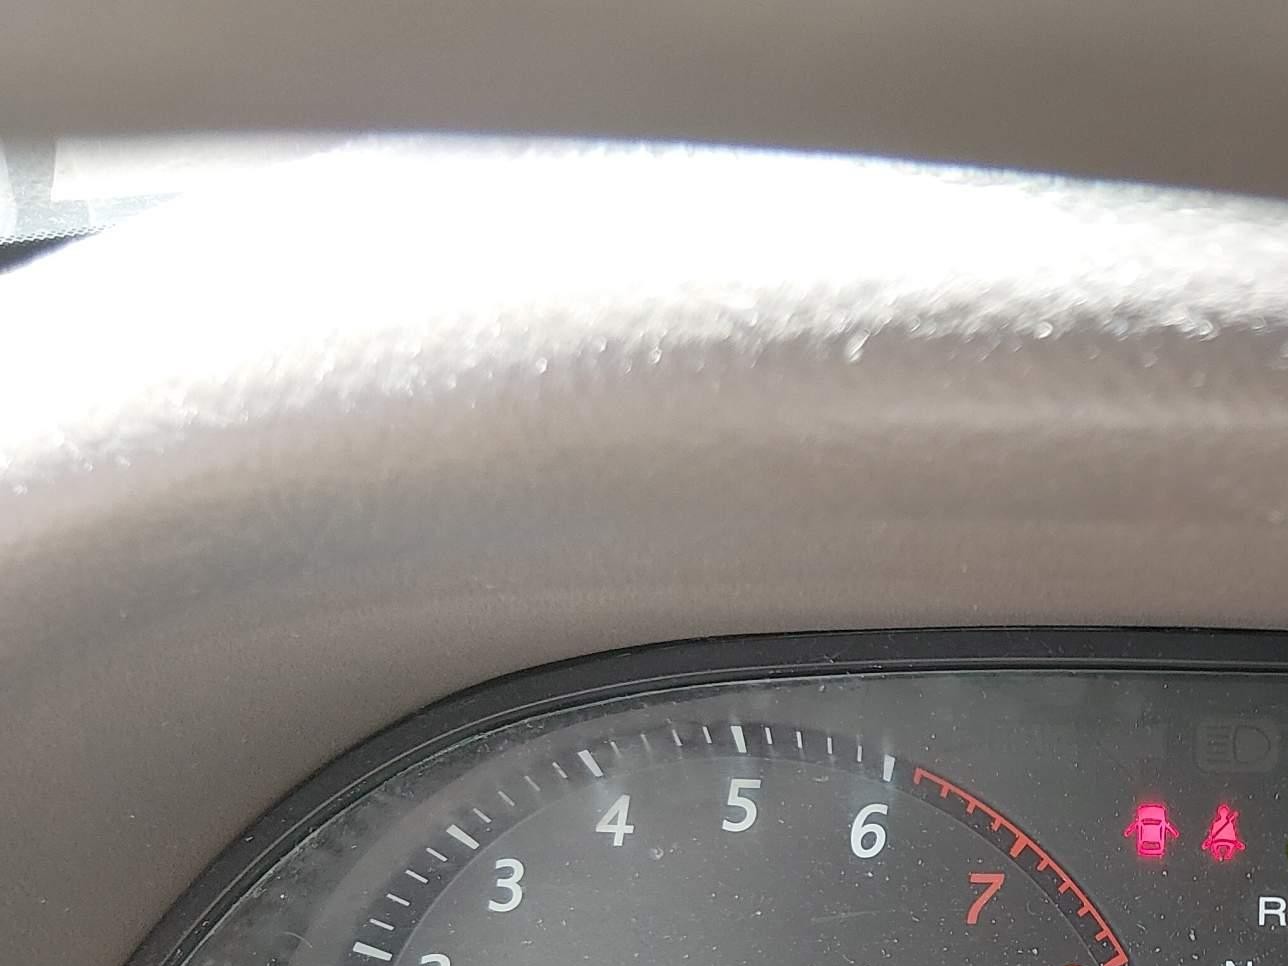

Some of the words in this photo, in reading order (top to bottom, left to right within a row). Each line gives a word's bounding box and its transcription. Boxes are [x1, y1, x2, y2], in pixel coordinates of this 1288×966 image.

[595, 794, 635, 847] 4
[722, 778, 762, 832] 5
[849, 803, 889, 859] 6
[488, 858, 525, 912] 3
[966, 872, 1006, 925] 7
[1258, 896, 1288, 927] R
